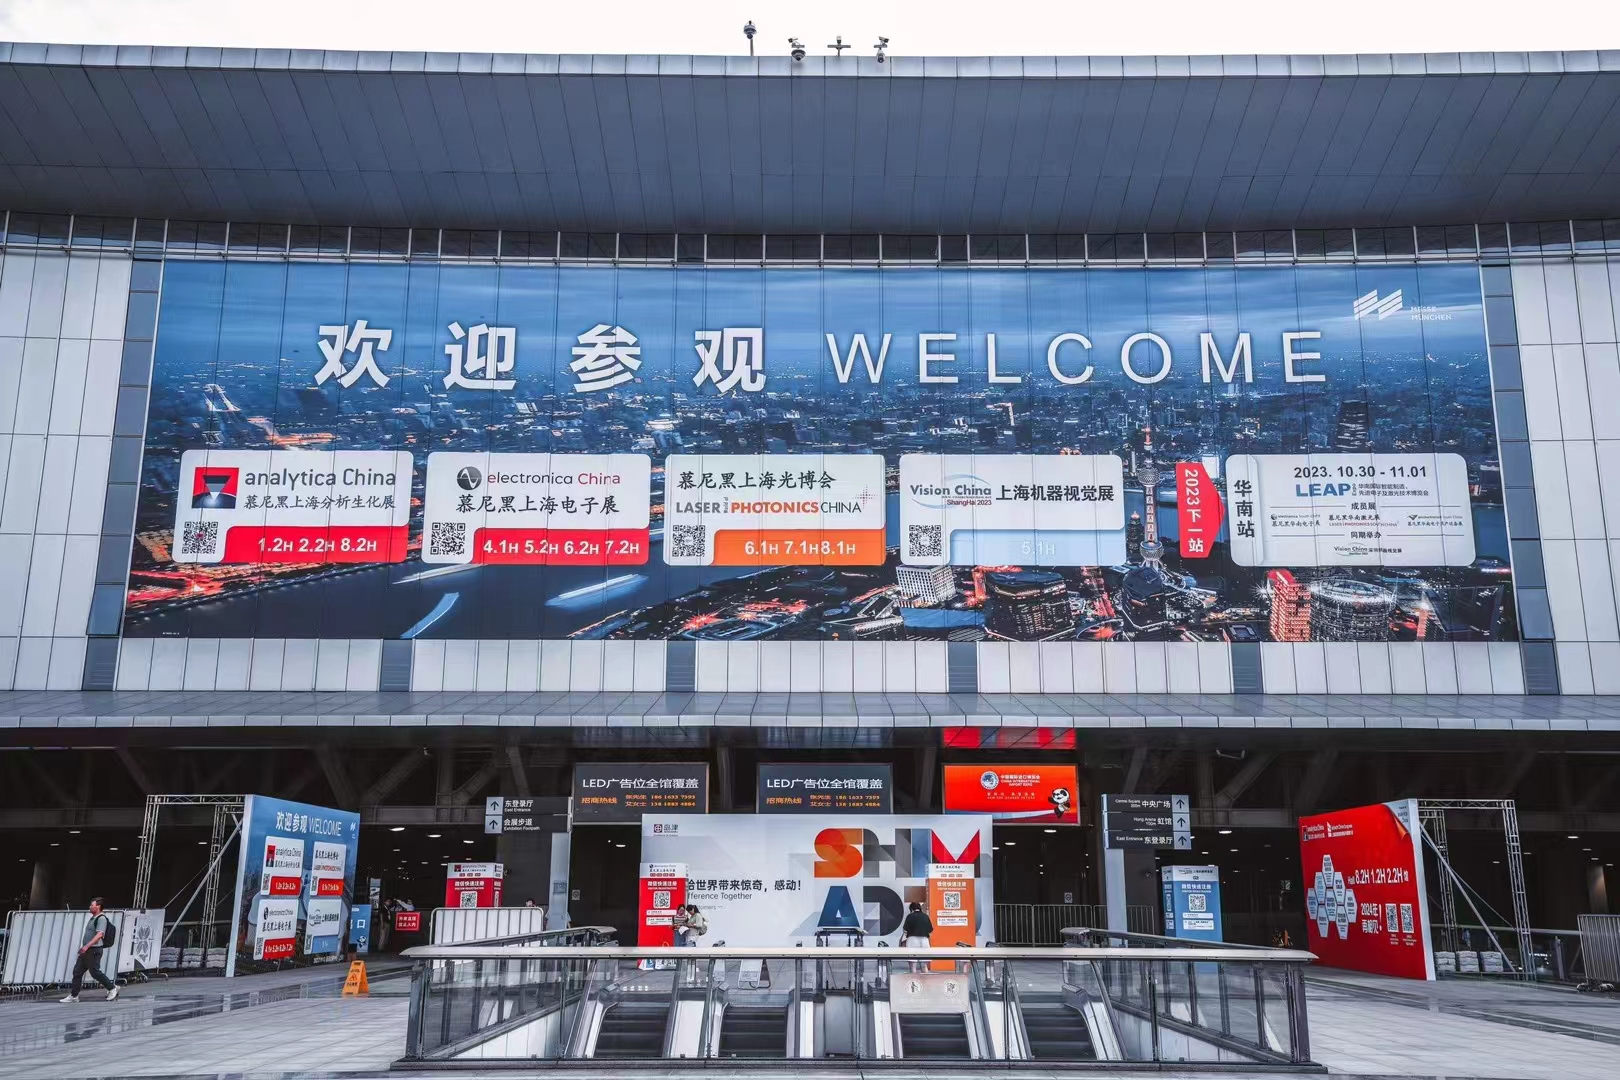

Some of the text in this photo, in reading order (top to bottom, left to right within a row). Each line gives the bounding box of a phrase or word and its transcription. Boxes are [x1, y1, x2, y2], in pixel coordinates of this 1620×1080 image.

[314, 319, 1326, 393] 欢迎参观 WELCOME
[488, 472, 620, 485] electronica China
[1294, 466, 1332, 478] 2023.
[1337, 466, 1376, 477] 10.30
[1390, 466, 1427, 477] 11.01
[245, 468, 396, 490] analytica China
[677, 471, 836, 490] 慕尼黑上海光博会
[910, 484, 992, 496] Vision China
[996, 484, 1114, 502] 上海机器视觉展
[1296, 483, 1351, 497] LEAP
[244, 494, 396, 510] 慕尼黑上海分析生化展
[456, 494, 620, 515] 慕尼黑上海电子展
[676, 502, 721, 514] LASER
[731, 502, 819, 514] PHOTONICS
[820, 502, 862, 514] CHINA
[947, 499, 976, 507] ShangHai
[1234, 479, 1255, 537] 华南站
[1351, 502, 1376, 510] 成员展
[1184, 469, 1203, 553] 2023下一站
[1350, 531, 1382, 539] 同期举办
[258, 538, 377, 552] 1.2H 2.2H 8.2H
[483, 540, 640, 555] 4.1H 5.2H 6.2H 7.2H
[745, 541, 856, 555] 6.1H 7.1H 8.1H
[1022, 542, 1055, 555] 5.1H
[582, 778, 698, 789] LED广告位全馆覆盖
[767, 778, 883, 789] LED广告位全馆覆盖
[505, 800, 533, 808] 东登录厅
[1142, 800, 1171, 808] 中央广场
[276, 811, 342, 836] 欢迎参观 WELCOME
[504, 818, 533, 826] 会展步道
[1157, 817, 1172, 825] 虹馆
[1144, 836, 1173, 844] 东登录厅
[1355, 869, 1370, 884] 8.2H
[1371, 869, 1386, 884] 1.2H
[1387, 867, 1404, 883] 2.2H
[721, 892, 752, 901] Together
[1360, 903, 1379, 917] 2024年
